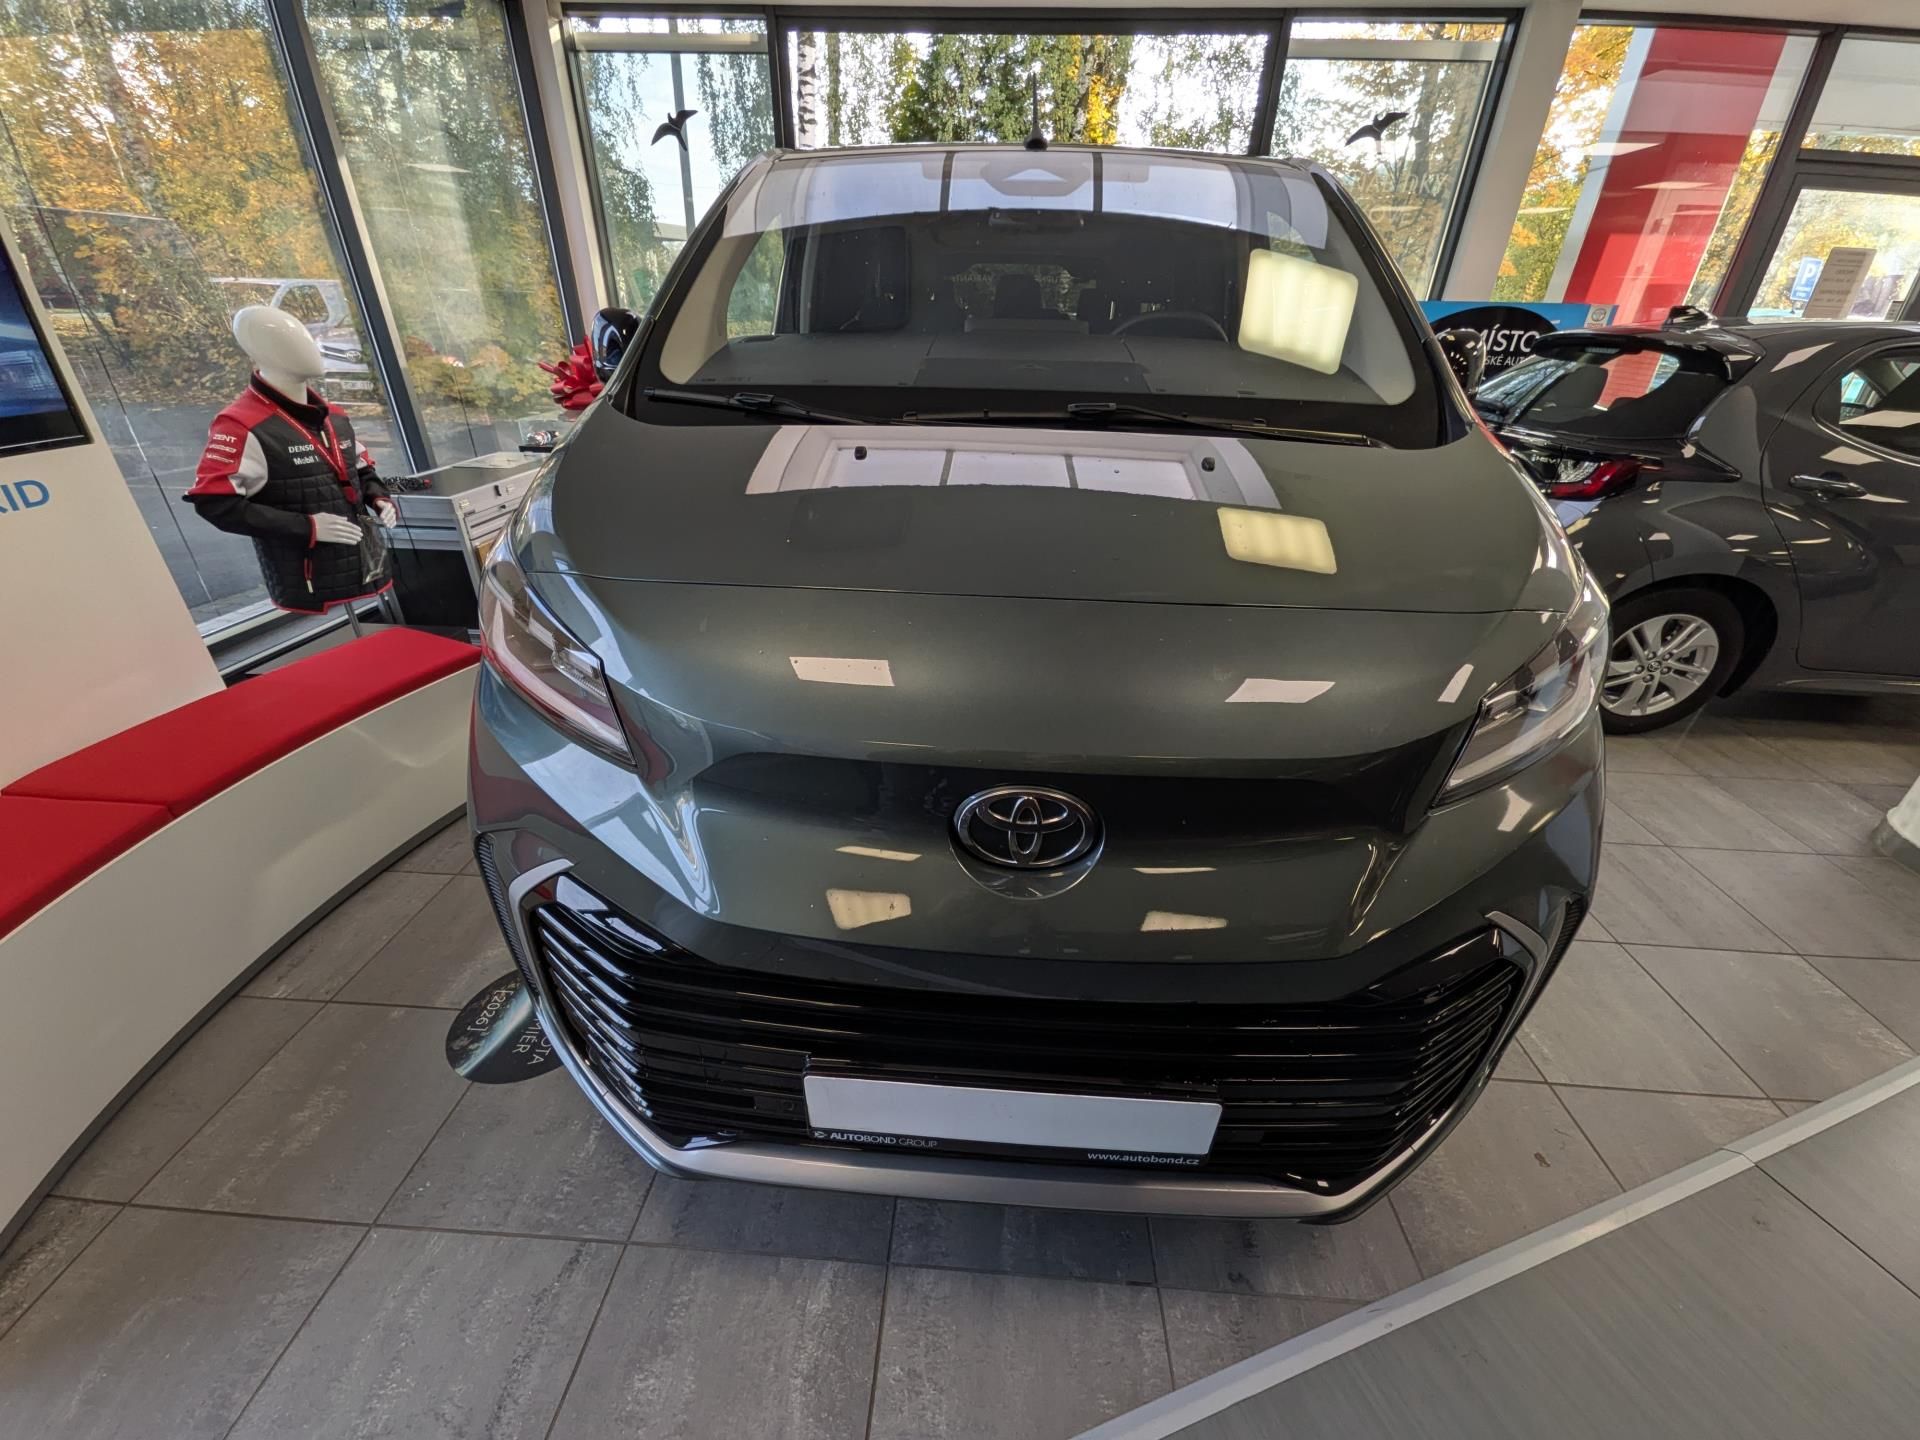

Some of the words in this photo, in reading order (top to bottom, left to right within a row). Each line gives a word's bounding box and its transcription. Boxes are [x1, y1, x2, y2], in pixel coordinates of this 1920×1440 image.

[288, 444, 315, 453] DENSO
[293, 456, 314, 465] Mobil
[0, 479, 50, 514] ID
[830, 1132, 897, 1145] AUTOBOND
[898, 1138, 938, 1148] GROUP
[1087, 1152, 1200, 1165] www.autobond.cz
